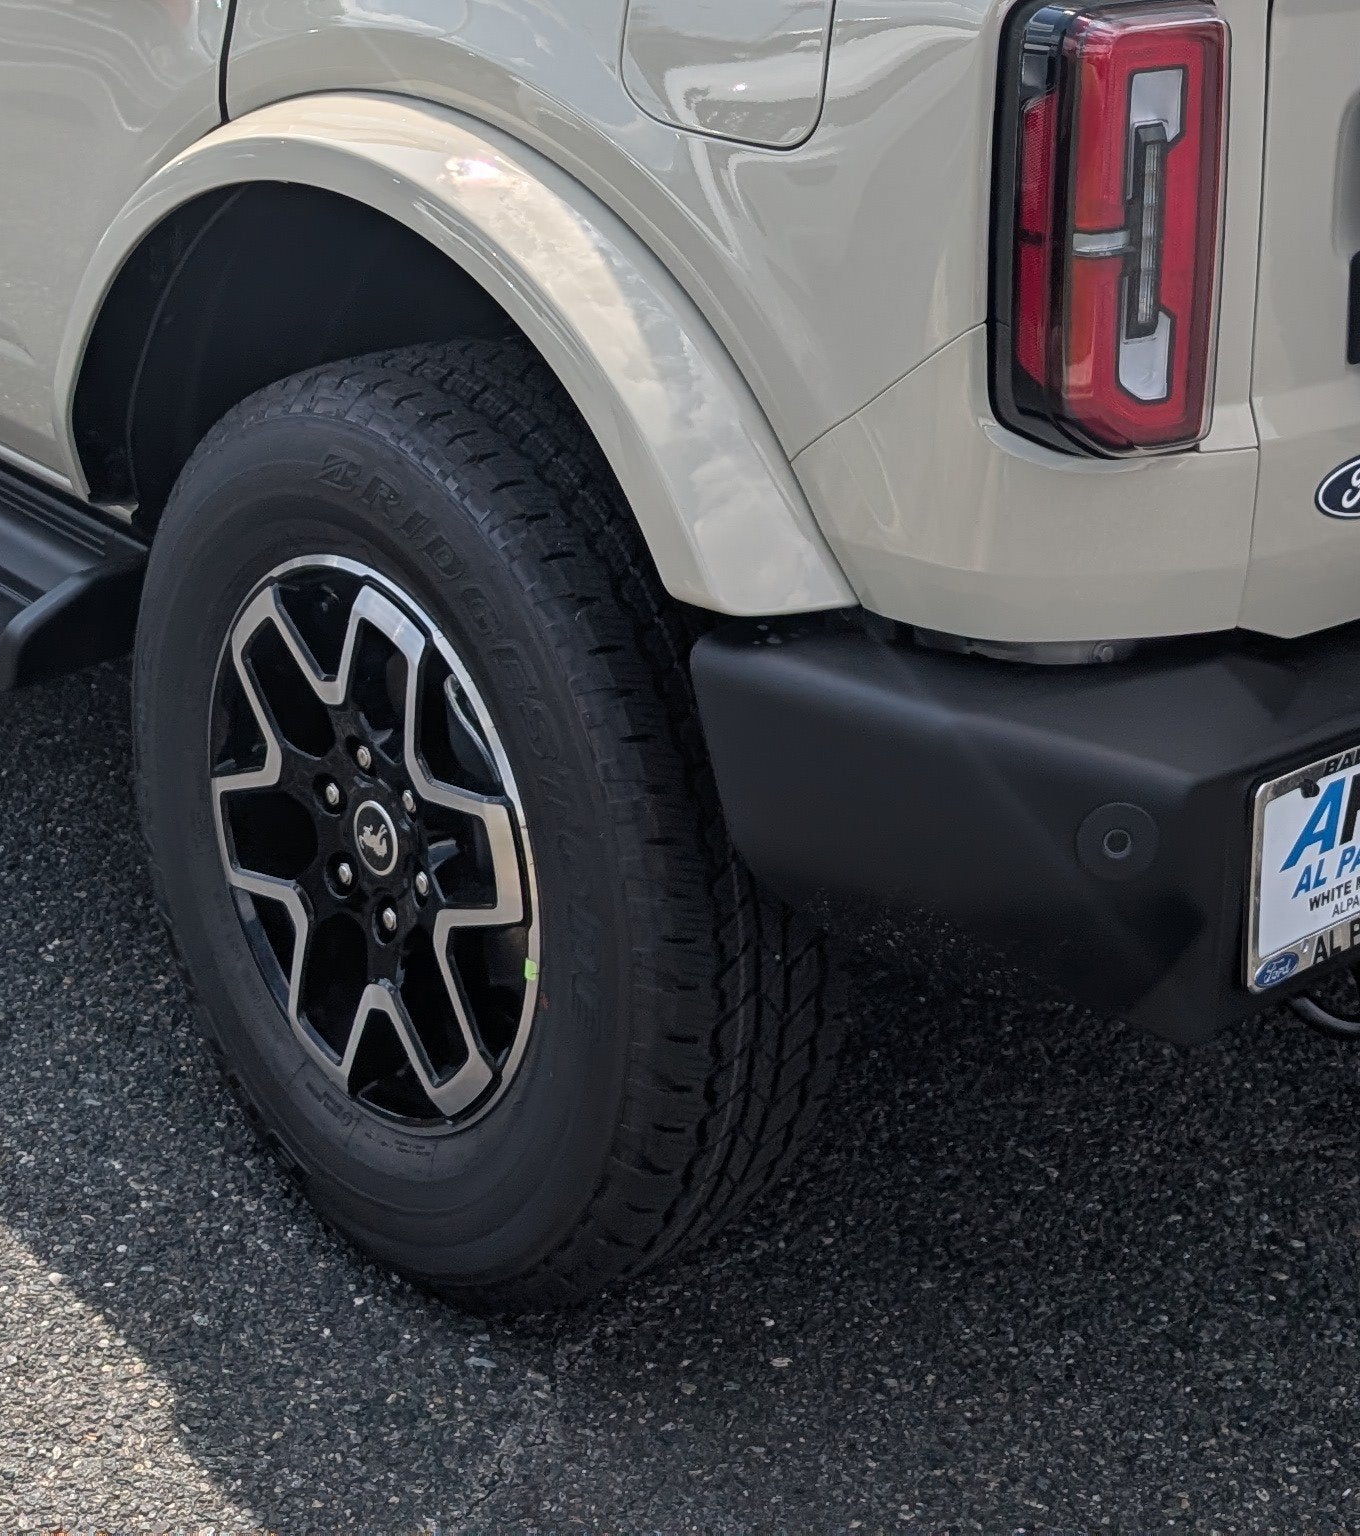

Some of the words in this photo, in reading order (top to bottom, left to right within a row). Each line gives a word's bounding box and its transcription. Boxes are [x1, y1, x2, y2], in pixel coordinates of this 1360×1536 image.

[1291, 858, 1328, 900] AL
[1308, 880, 1352, 912] WHITE
[1312, 929, 1342, 965] AL
[1260, 955, 1294, 985] Ford
